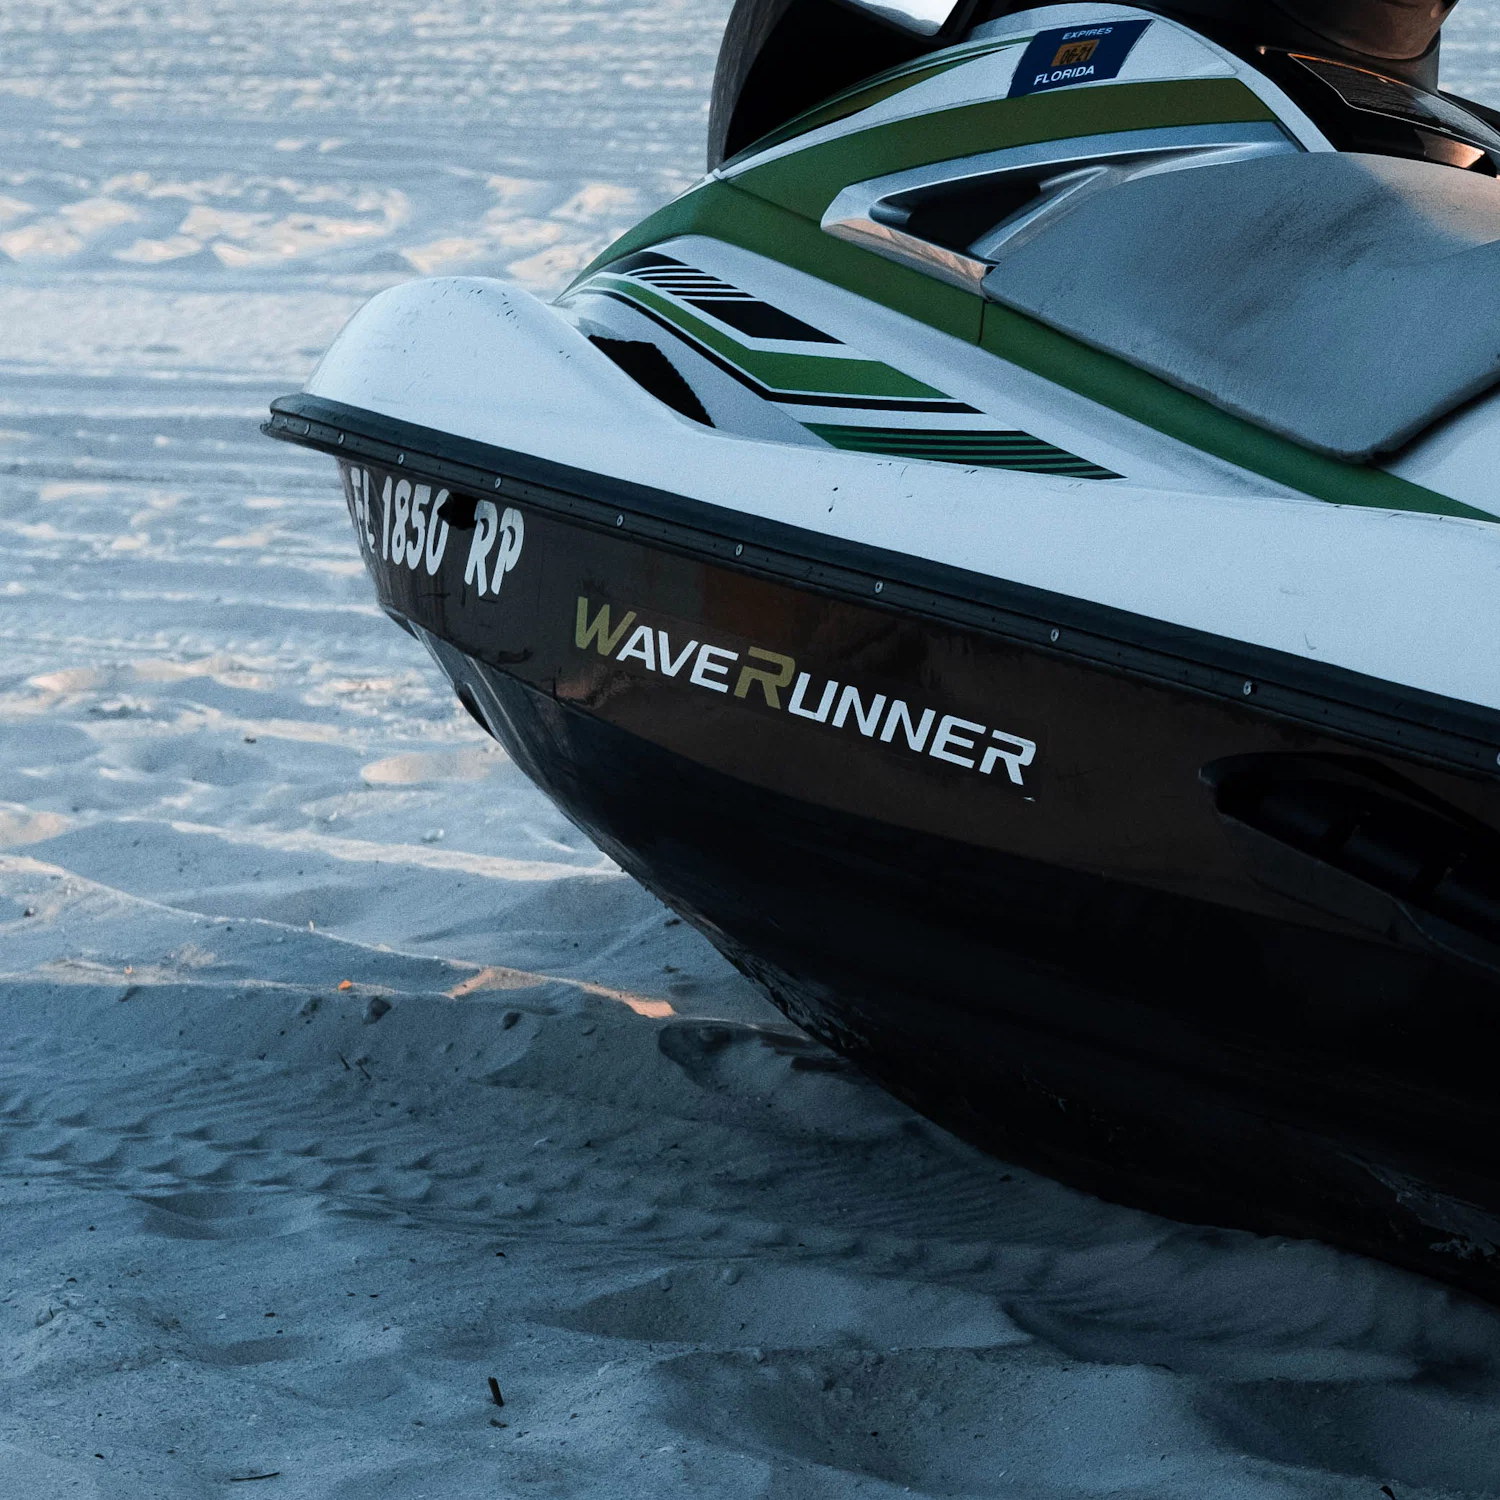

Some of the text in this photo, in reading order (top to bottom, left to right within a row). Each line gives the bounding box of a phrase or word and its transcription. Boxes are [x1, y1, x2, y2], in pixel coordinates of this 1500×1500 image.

[1062, 27, 1114, 40] EXPIRES
[1033, 65, 1095, 86] FLORIDA
[464, 499, 525, 597] RP
